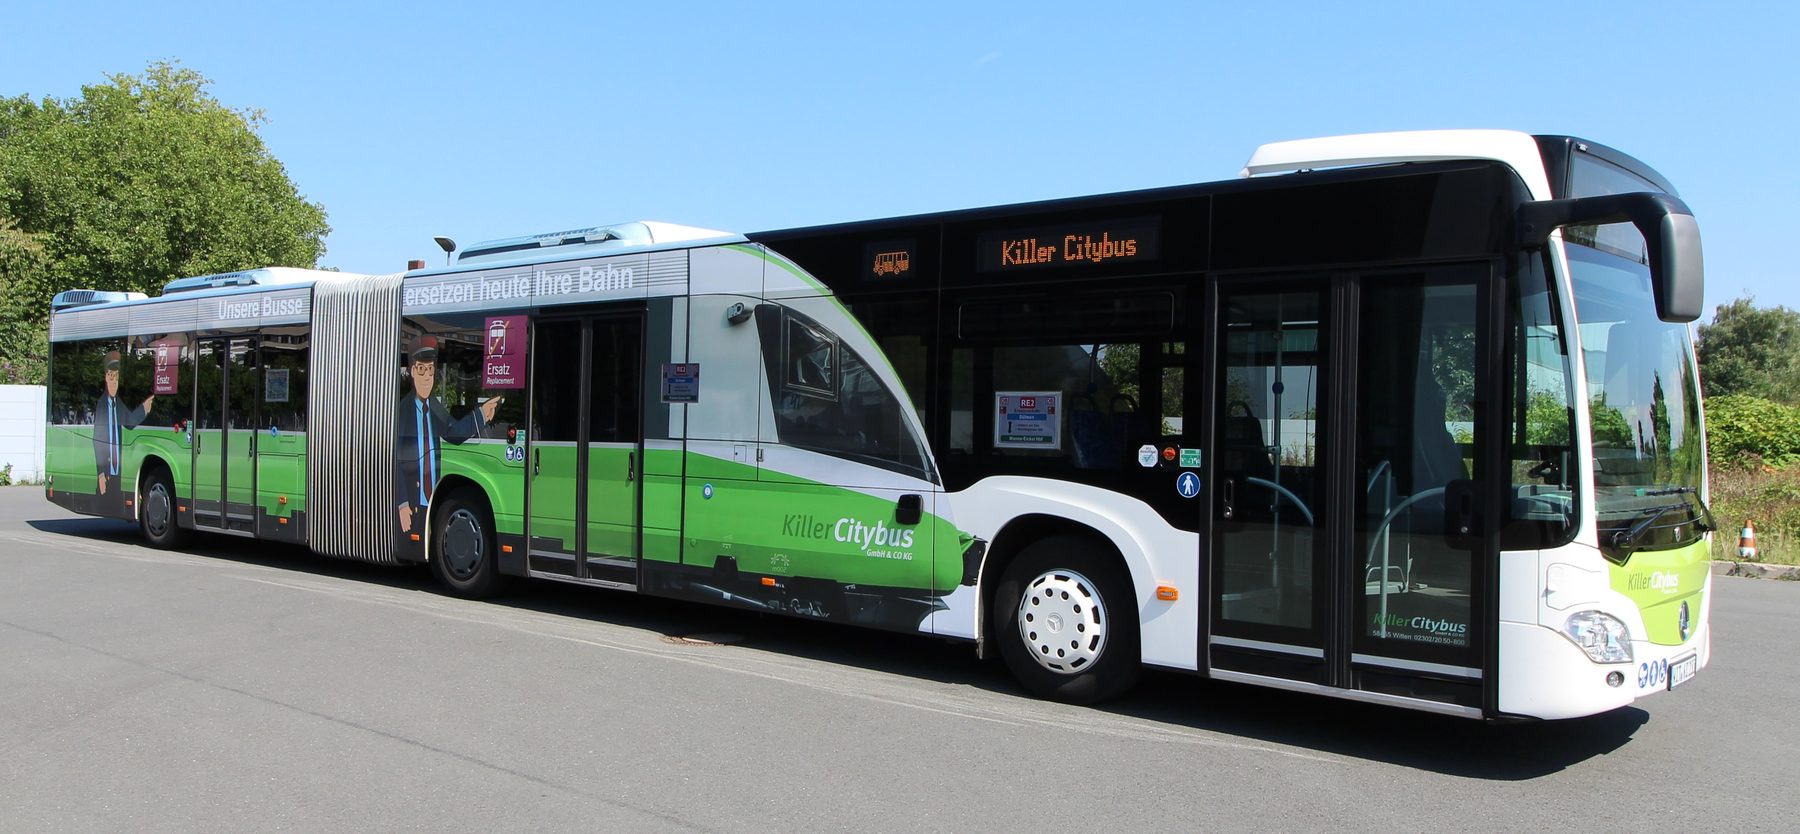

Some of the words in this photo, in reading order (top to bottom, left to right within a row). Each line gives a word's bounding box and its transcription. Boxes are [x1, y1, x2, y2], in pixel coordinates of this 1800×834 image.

[1002, 238, 1057, 266] Killer
[1063, 232, 1137, 263] Citybus
[404, 281, 474, 306] ersetzen
[479, 276, 531, 300] heute
[535, 270, 573, 296] Ihre
[579, 263, 633, 293] Bahn
[218, 299, 260, 320] Unsere
[262, 296, 303, 317] Busse
[487, 362, 510, 375] Ersatz
[486, 376, 515, 386] Replacement
[1020, 399, 1035, 407] RE2
[866, 548, 886, 558] GmbH
[886, 550, 892, 559] &
[893, 551, 902, 560] CO
[902, 552, 913, 561] KG
